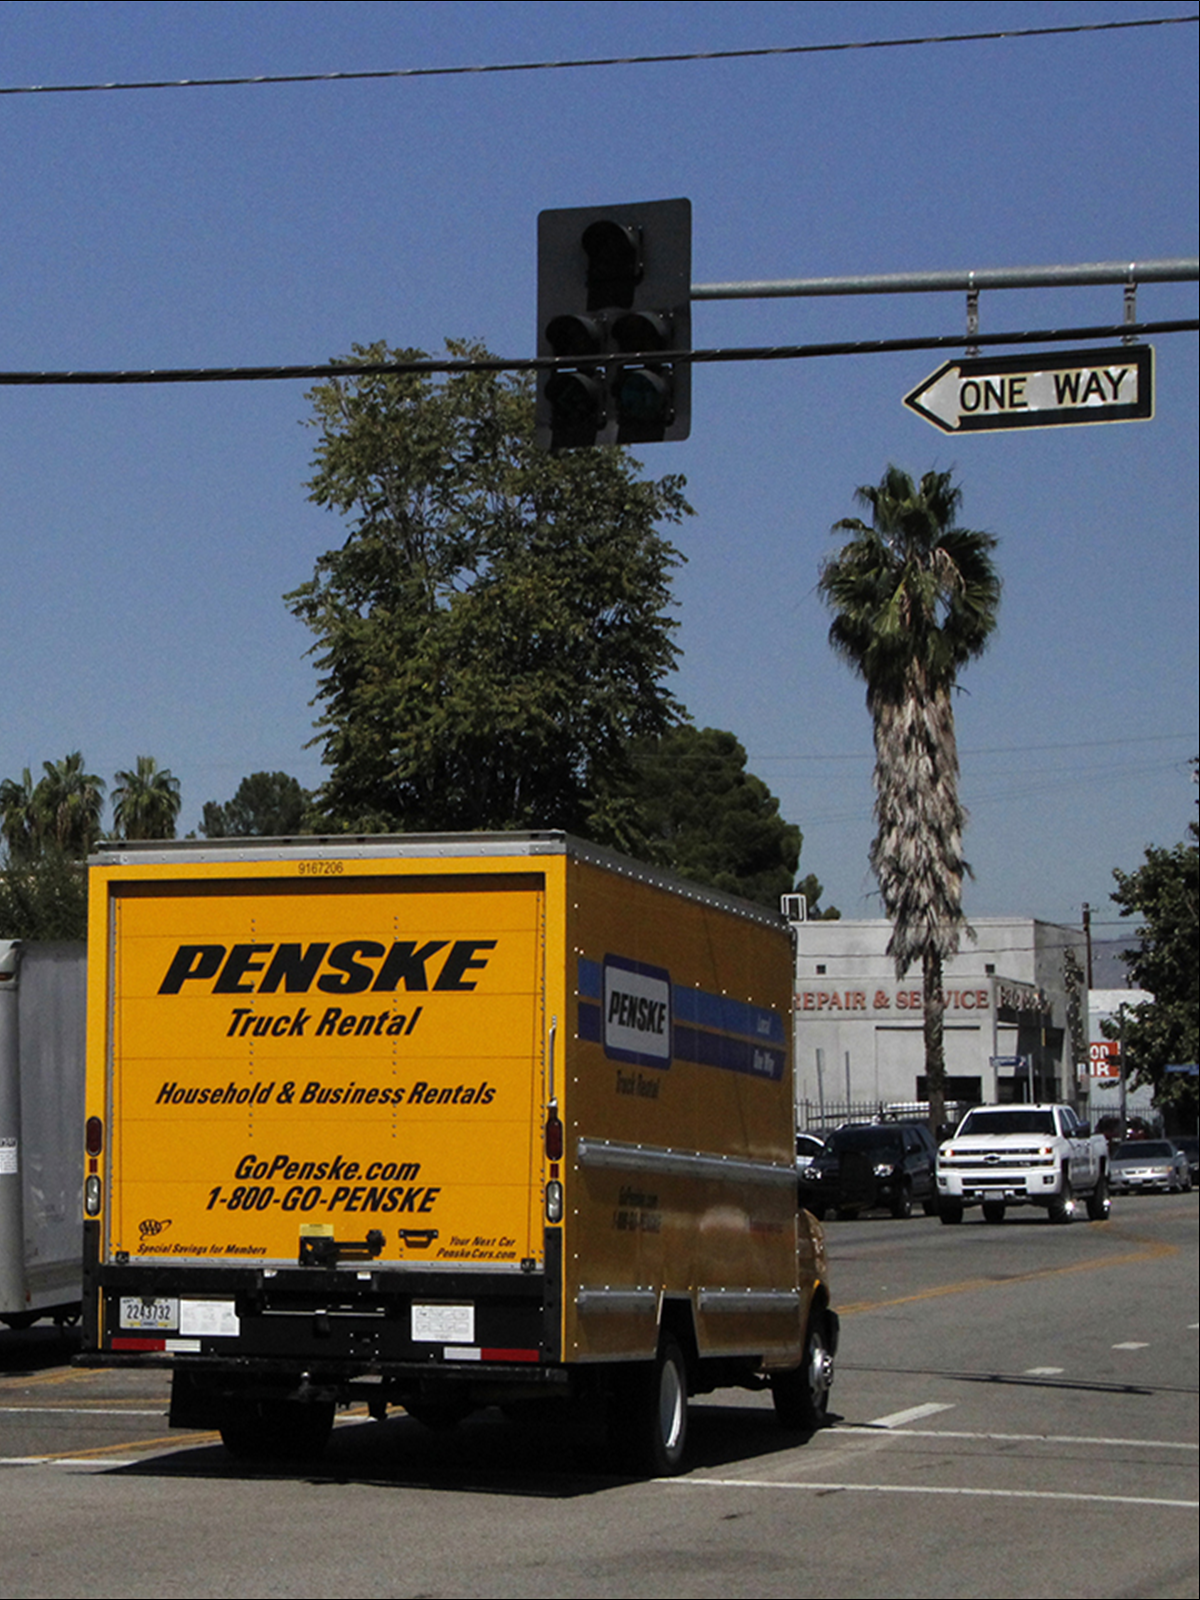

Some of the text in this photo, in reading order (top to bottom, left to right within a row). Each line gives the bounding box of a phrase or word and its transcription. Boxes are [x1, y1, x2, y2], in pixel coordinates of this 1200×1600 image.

[959, 368, 1129, 412] ONE WAY
[298, 862, 344, 875] 9167206
[156, 939, 499, 995] PENSKE
[607, 990, 668, 1035] PENSKE
[873, 989, 890, 1010] &
[895, 989, 989, 1010] SEVICE
[226, 1006, 424, 1037] Truck Rental
[155, 1081, 497, 1105] Household & Business Rentals
[234, 1154, 422, 1182] GoPenske.com
[205, 1186, 441, 1213] 1-800-GO-PENSKE
[137, 1243, 268, 1256] Special Savings for Members
[449, 1236, 516, 1247] Your Next Car
